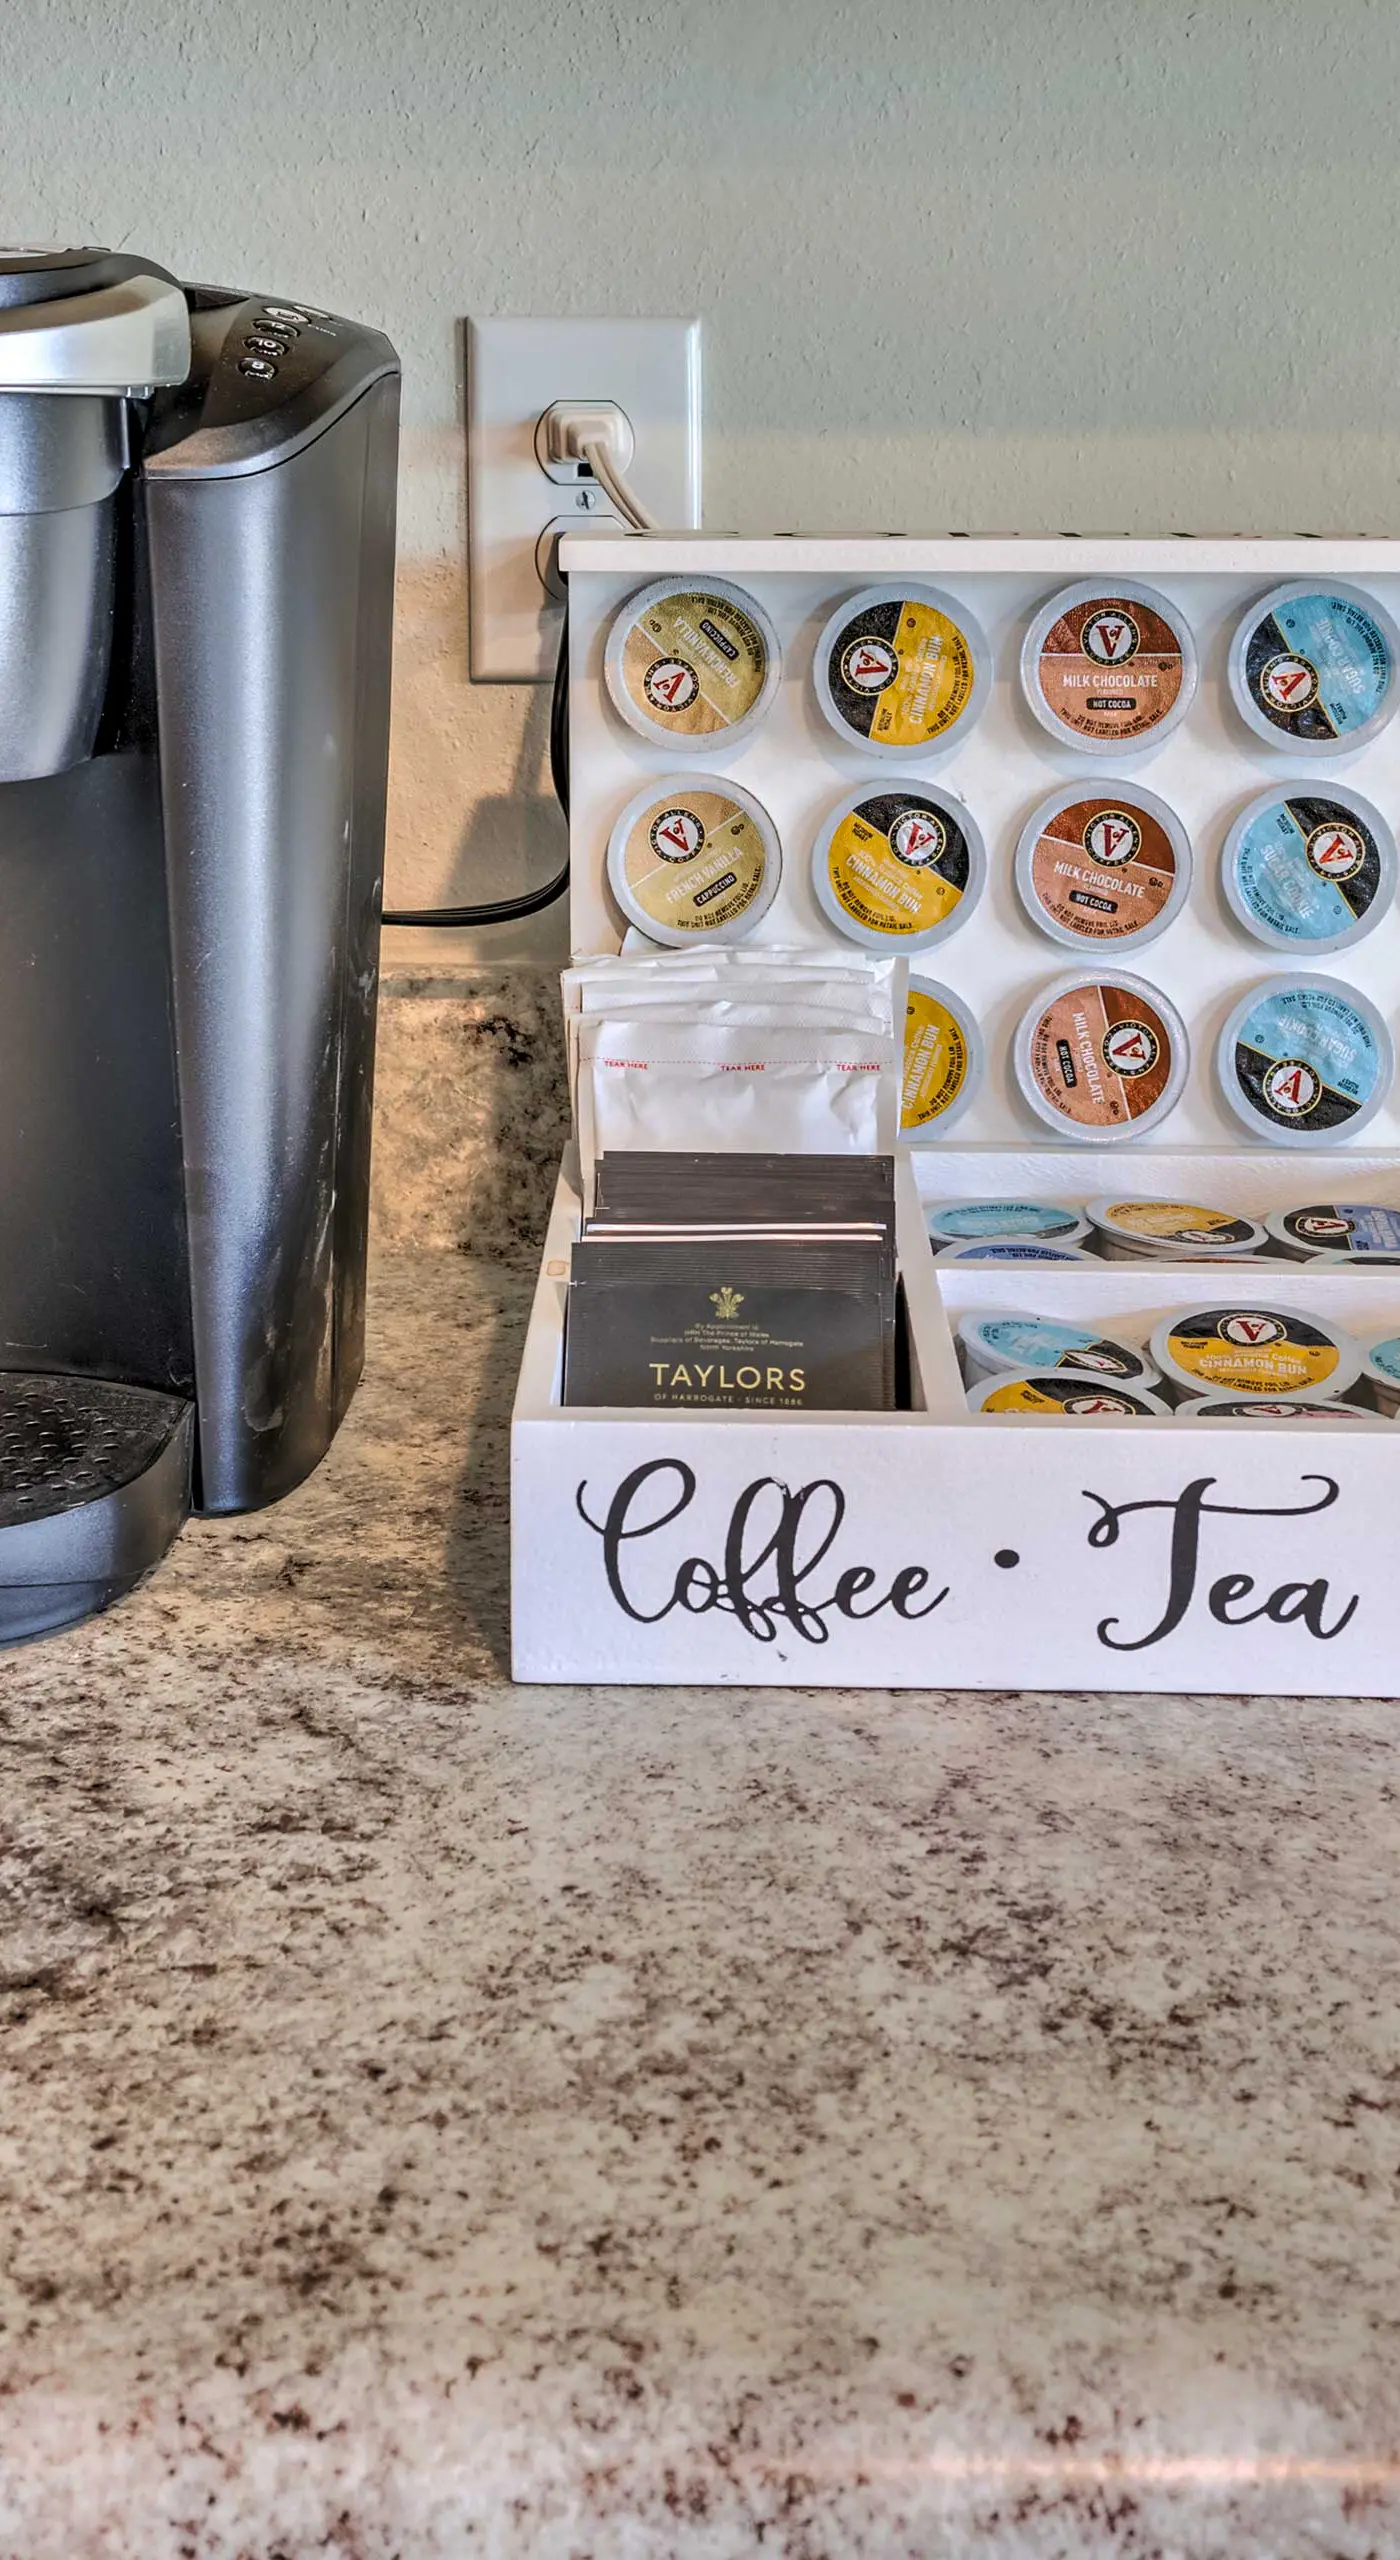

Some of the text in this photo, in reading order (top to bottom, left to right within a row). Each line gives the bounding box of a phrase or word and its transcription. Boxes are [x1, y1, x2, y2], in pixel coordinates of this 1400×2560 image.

[259, 340, 276, 348] 10
[252, 361, 264, 369] 8
[672, 617, 710, 657] VANILLA
[702, 621, 736, 657] CAPPUCCINO
[704, 653, 739, 688] FRENCH
[909, 662, 936, 724] CINNAMON
[926, 636, 942, 660] BUN
[1063, 676, 1158, 687] MILK CHOCOLATE
[1093, 700, 1131, 708] HOT COCOA
[665, 846, 743, 903] FRENCH VANILLA
[696, 874, 735, 904] CAPPUCCINO
[845, 854, 901, 899] CINNAMON
[898, 892, 922, 914] BUN
[1054, 862, 1081, 879] MILK
[1082, 870, 1145, 898] CHOCOLATE
[1076, 894, 1112, 911] HOT COCOA
[1073, 1012, 1089, 1039] MILK
[605, 1060, 648, 1070] TEAR HERE
[901, 1049, 931, 1109] CINNAMON
[921, 1024, 939, 1048] BUN
[1060, 1046, 1074, 1083] HOT COCOA
[1080, 1041, 1105, 1104] CHOCOLATE
[649, 1363, 805, 1391] TAYLORS
[1200, 1358, 1307, 1374] CINNAMON BUN
[654, 1393, 667, 1401] OF
[672, 1394, 734, 1403] HARROGATE
[745, 1396, 775, 1405] SINCE
[576, 1458, 1360, 1651] Coffee Tea
